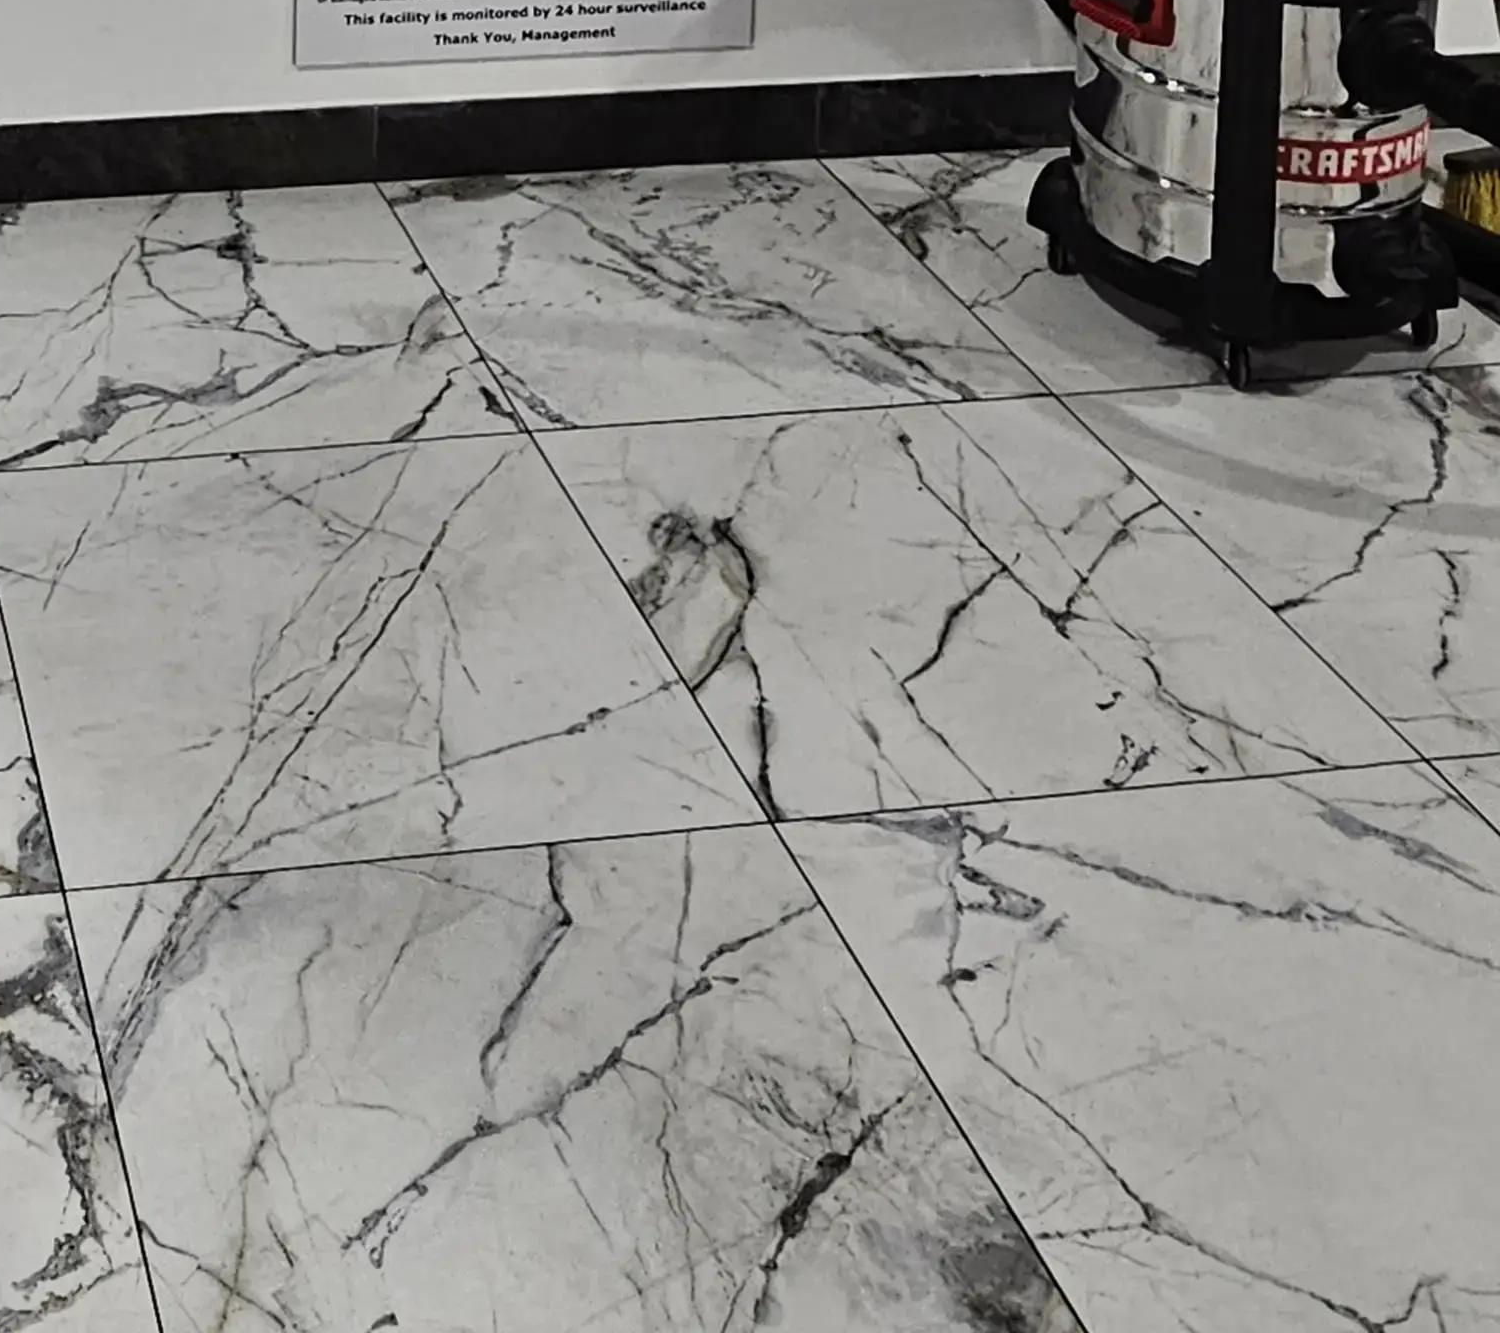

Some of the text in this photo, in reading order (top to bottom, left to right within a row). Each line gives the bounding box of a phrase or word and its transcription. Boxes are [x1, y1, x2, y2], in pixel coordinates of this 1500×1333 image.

[345, 0, 706, 25] This facility is monitored by 24 hour surveillance
[434, 26, 615, 46] Thank You, Management
